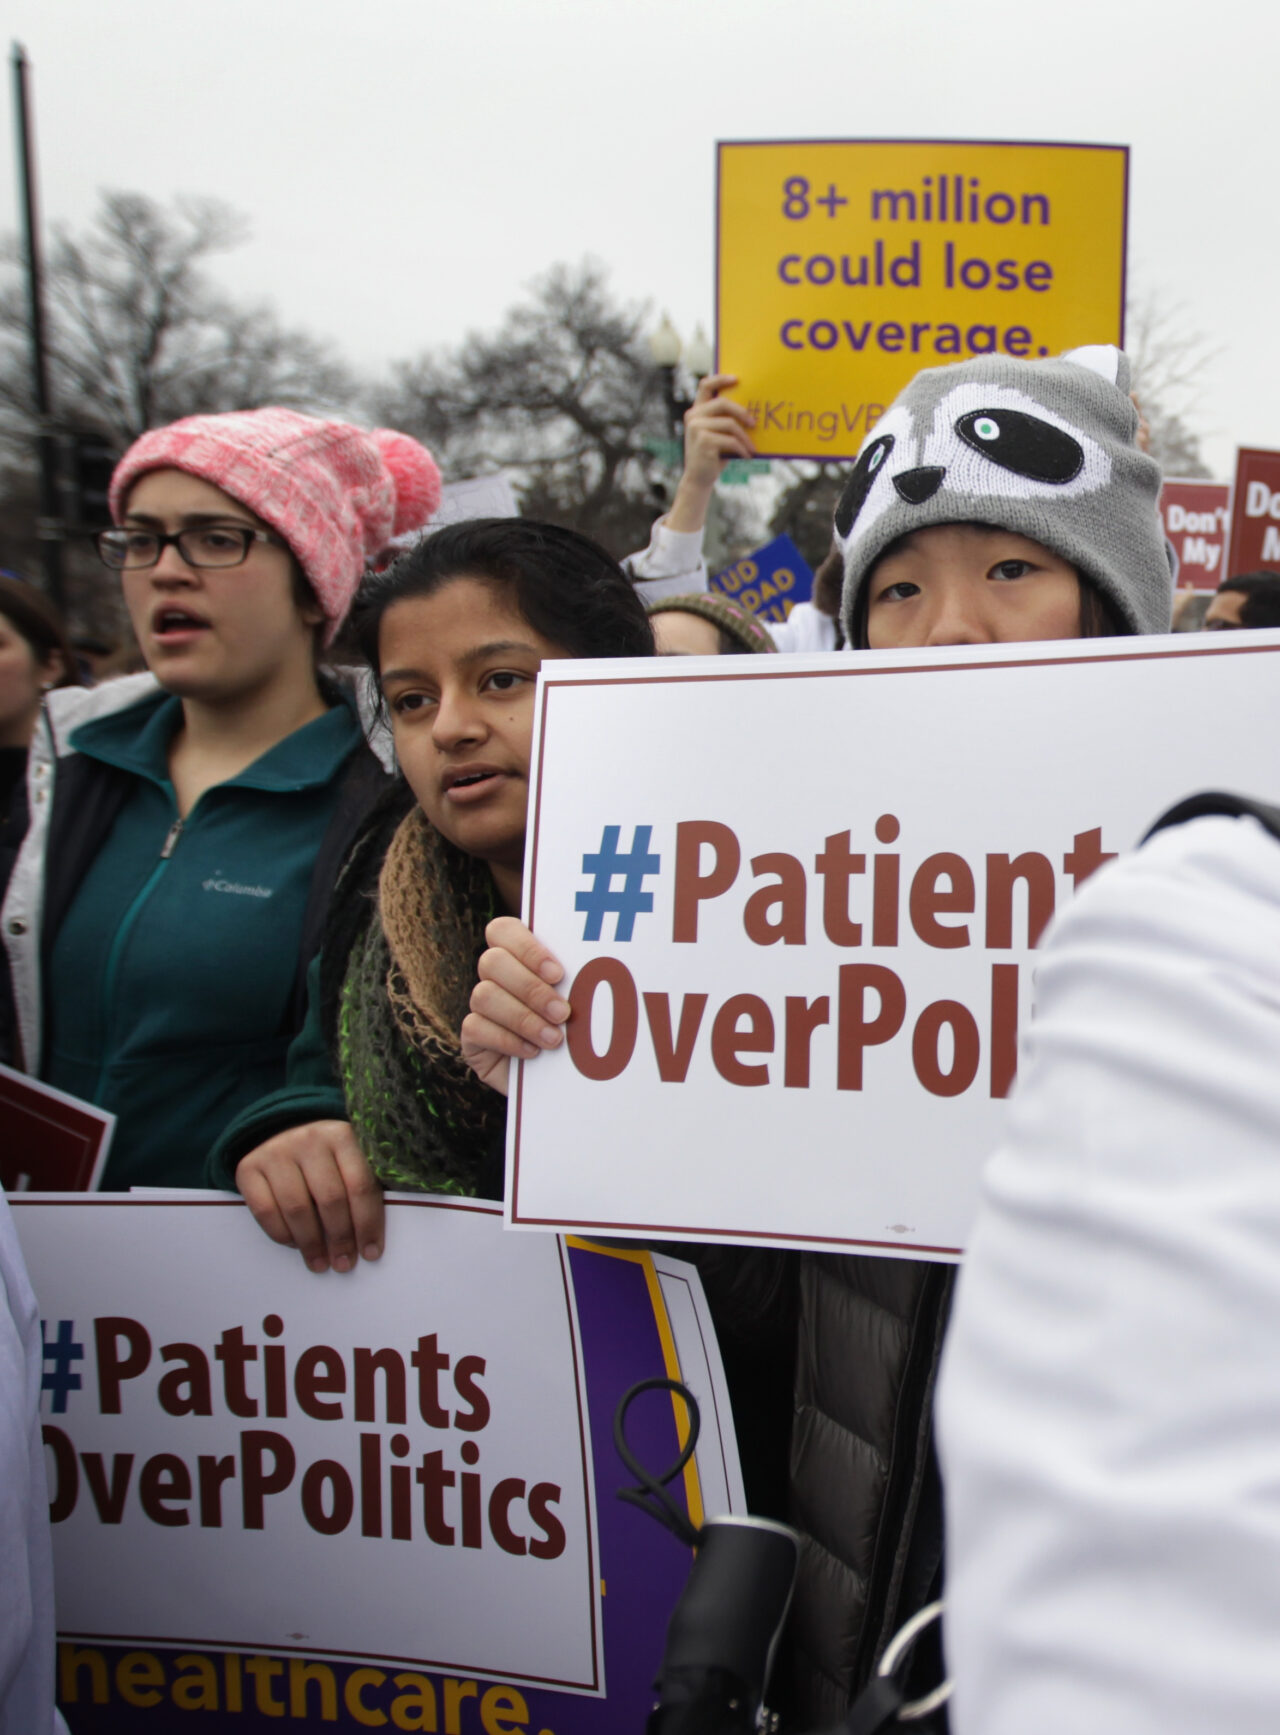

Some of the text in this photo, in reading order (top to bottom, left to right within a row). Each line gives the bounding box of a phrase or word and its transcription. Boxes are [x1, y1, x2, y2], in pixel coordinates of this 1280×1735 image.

[781, 174, 1051, 226] 8+ million
[777, 239, 1054, 293] could lose
[779, 318, 1049, 358] coverage.
[1183, 536, 1221, 571] My
[566, 955, 1019, 1100] OverPol
[40, 1313, 491, 1432] #Patients
